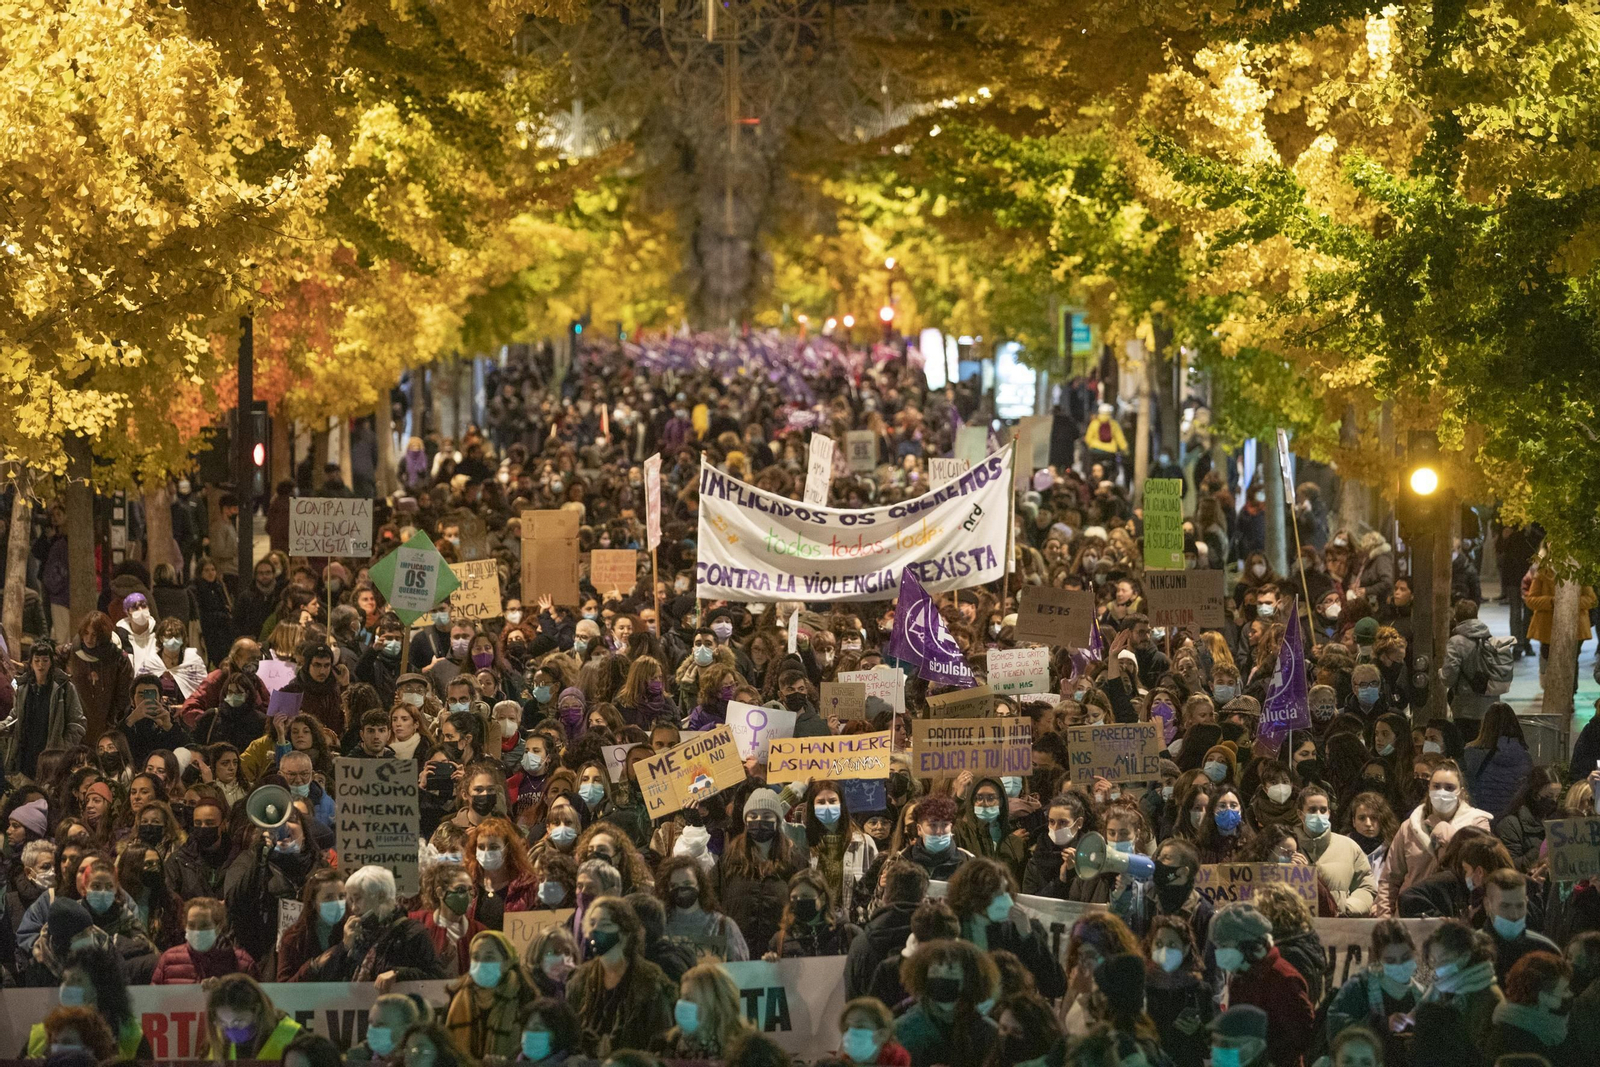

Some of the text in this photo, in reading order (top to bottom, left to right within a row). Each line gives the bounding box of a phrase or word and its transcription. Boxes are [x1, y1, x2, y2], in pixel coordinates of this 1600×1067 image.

[700, 457, 1003, 526] IMPLICADOS OS QUEREMOS
[1144, 480, 1179, 495] GANANDO
[295, 500, 369, 518] CONTRA LA
[294, 520, 361, 538] VIOLENCIA
[1163, 515, 1181, 531] TODA
[295, 537, 348, 553] SEXISTA
[1153, 532, 1183, 549] SOCIEDAD
[400, 561, 435, 572] IMPLICADOS
[696, 544, 998, 595] CONTRA LA VIOLENCIA SEXISTA
[404, 569, 427, 589] OS
[1150, 574, 1187, 590] NINGUNA
[398, 586, 429, 596] QUEREMOS
[990, 653, 1014, 661] SOMOS
[1027, 650, 1046, 658] GRITO
[1016, 660, 1029, 668] QUE
[855, 673, 880, 681] MAYOR
[1004, 670, 1026, 678] TIENEN
[1029, 668, 1044, 676] VOZ
[928, 727, 974, 747] PROTEGE
[978, 726, 986, 745] A
[991, 726, 1005, 744] TU
[1069, 726, 1156, 742] TE PARECEMOS
[647, 730, 732, 780] ME CUIDAN
[771, 743, 795, 754] NO
[800, 741, 834, 754] HAN
[709, 748, 726, 764] NO
[920, 746, 1031, 772] EDUCA A TU HIJO
[1072, 751, 1092, 765] NOS
[342, 765, 363, 779] TU
[768, 759, 798, 773] LAS
[799, 758, 829, 771] HAN
[1078, 766, 1120, 780] FALTAN
[339, 783, 416, 797] CONSUMO
[341, 803, 414, 816] ALIMENTA
[649, 797, 666, 811] LA
[341, 820, 409, 833] LA TRATA
[342, 838, 350, 849] Y
[356, 838, 374, 849] LA
[1229, 866, 1253, 882] NO
